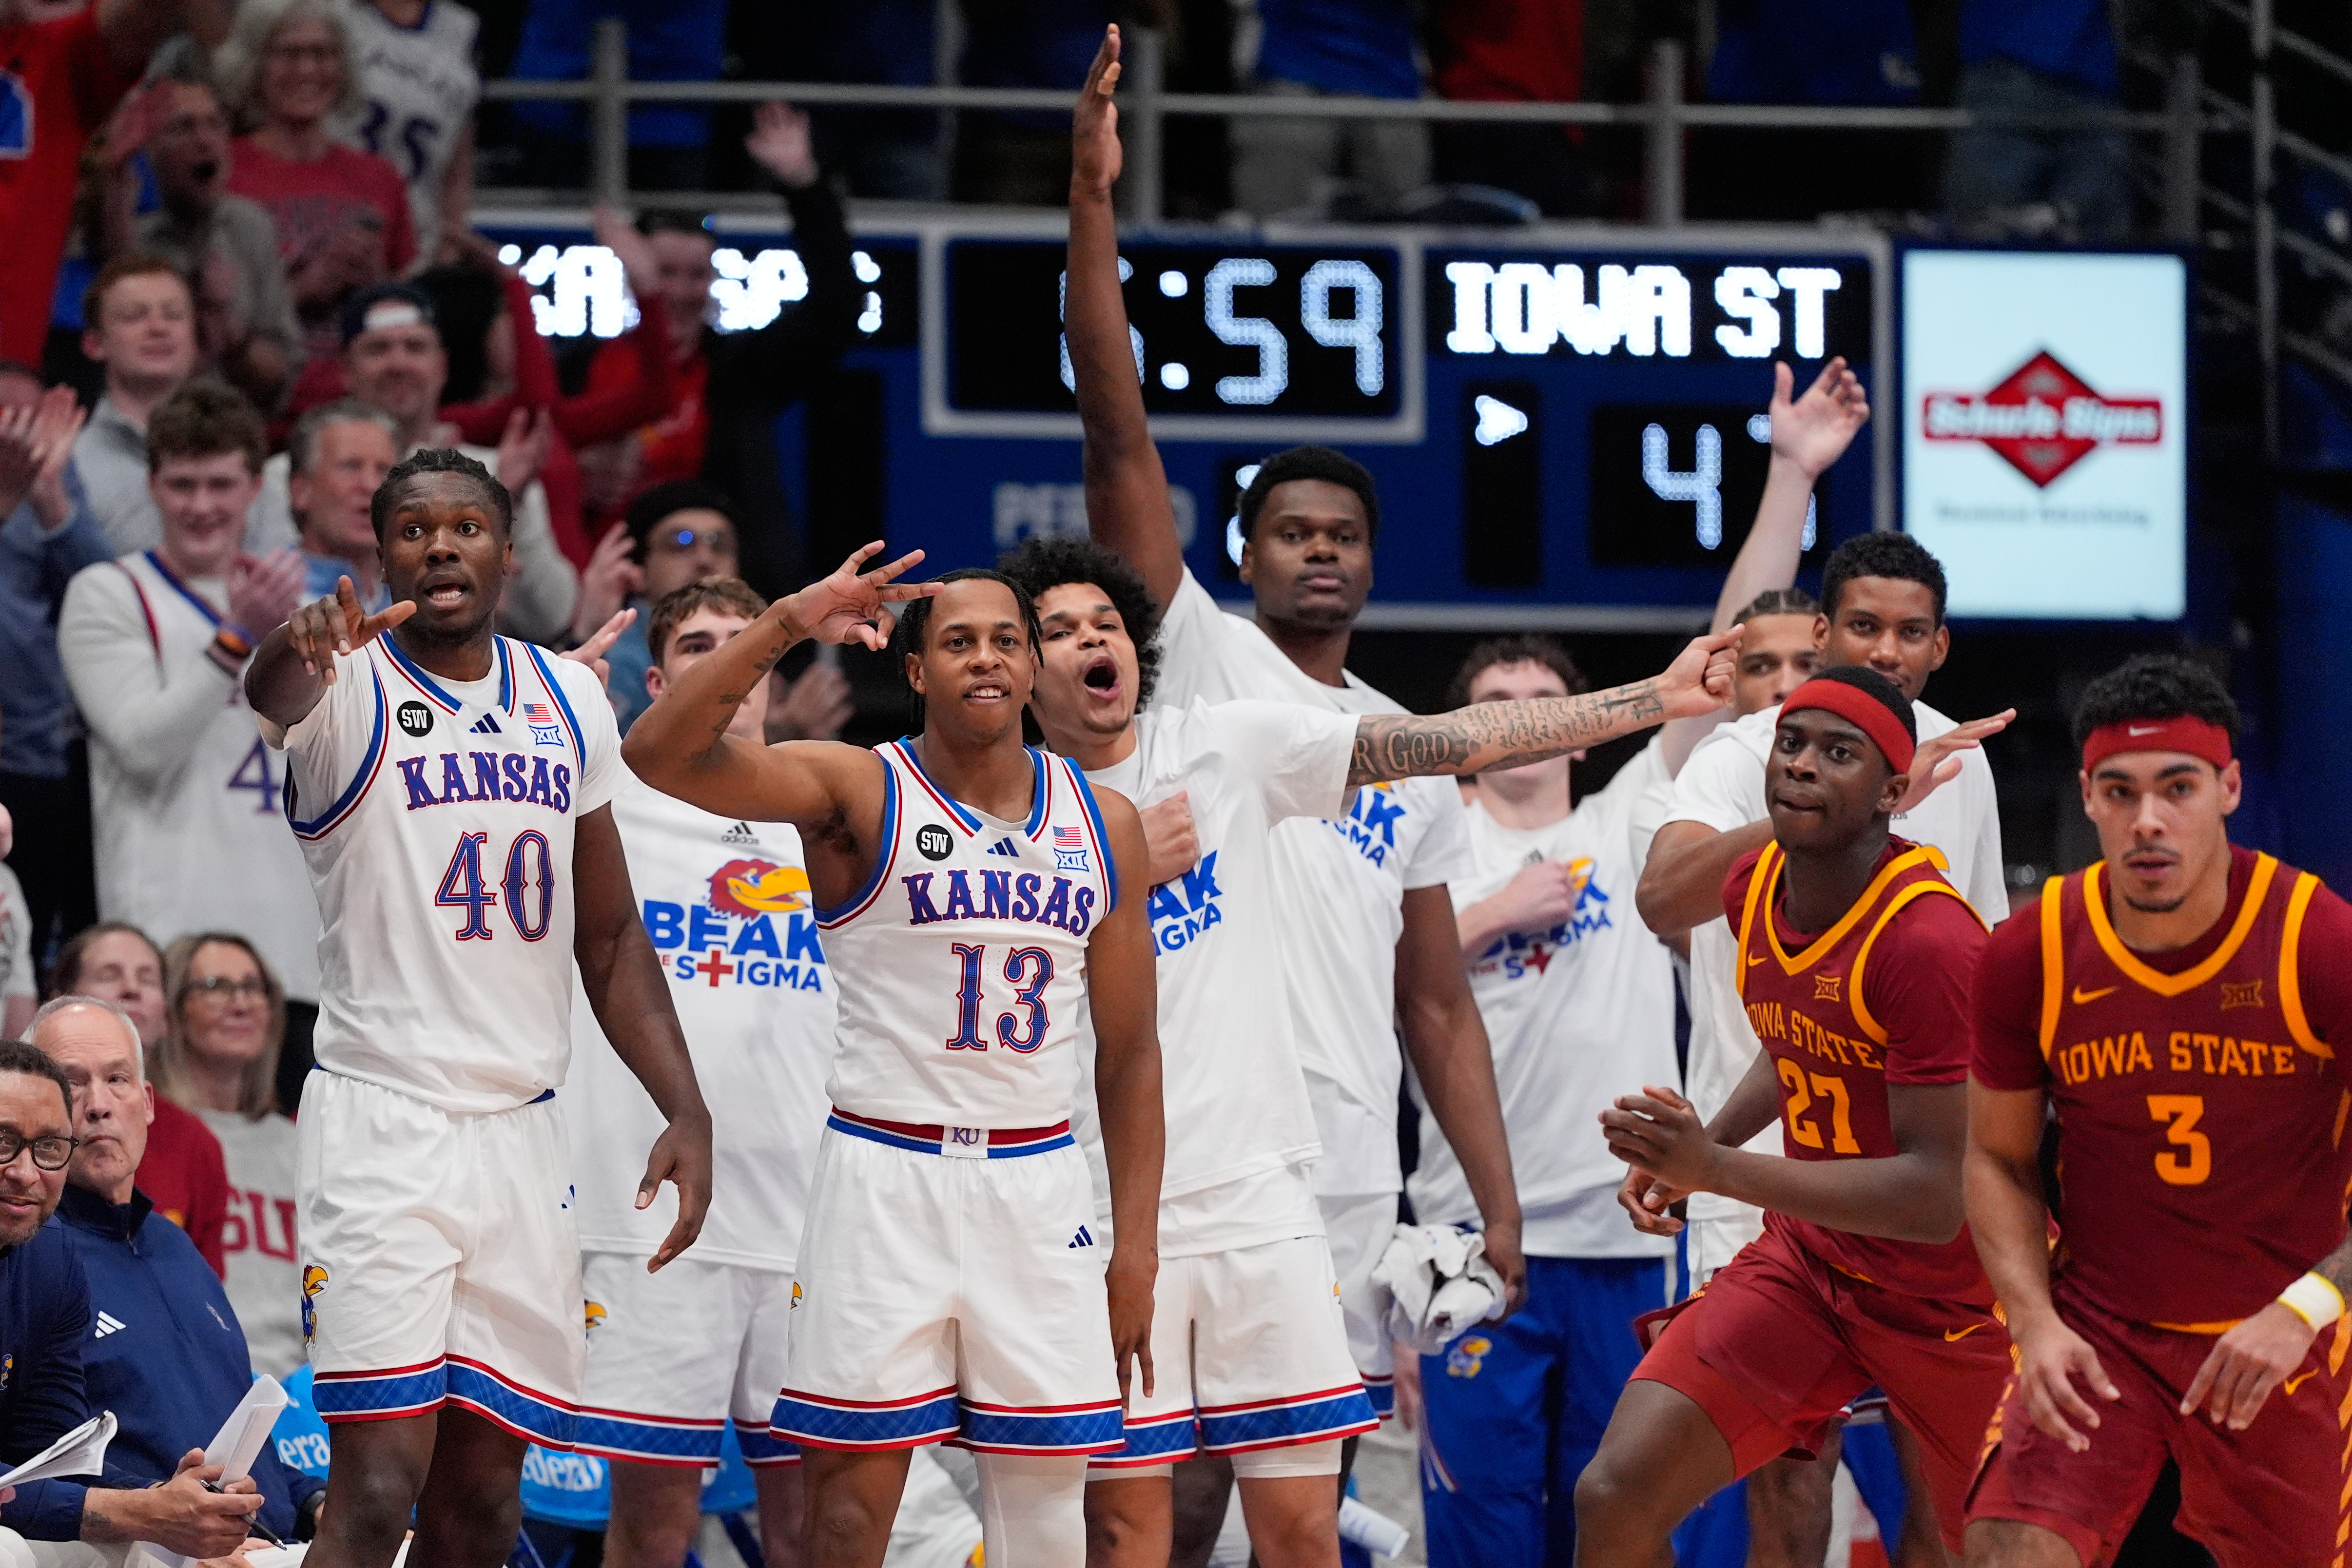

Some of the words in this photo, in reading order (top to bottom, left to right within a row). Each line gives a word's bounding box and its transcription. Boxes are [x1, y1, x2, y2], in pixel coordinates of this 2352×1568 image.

[1059, 256, 1383, 404] :59
[1446, 262, 1691, 357] IOWA
[1715, 266, 1842, 358] ST
[1642, 414, 1817, 551] 4
[401, 708, 428, 730] SW
[396, 751, 571, 814] KANSAS
[721, 832, 760, 846] adidas
[920, 831, 949, 854] SW
[435, 830, 555, 943] 40
[902, 870, 1095, 937] KANSAS
[1147, 849, 1224, 927] AK
[642, 899, 826, 965] BEAK
[1152, 902, 1222, 957] IGMA
[946, 943, 1054, 1054] 13
[1791, 1010, 1885, 1070] STATE
[2059, 1031, 2154, 1086] IOWA
[2169, 1031, 2296, 1077] STATE
[951, 1126, 981, 1146] KU
[1777, 1057, 1862, 1154] 27
[2146, 1094, 2212, 1185] 3
[220, 1184, 296, 1263] SU
[521, 1442, 603, 1492] deral
